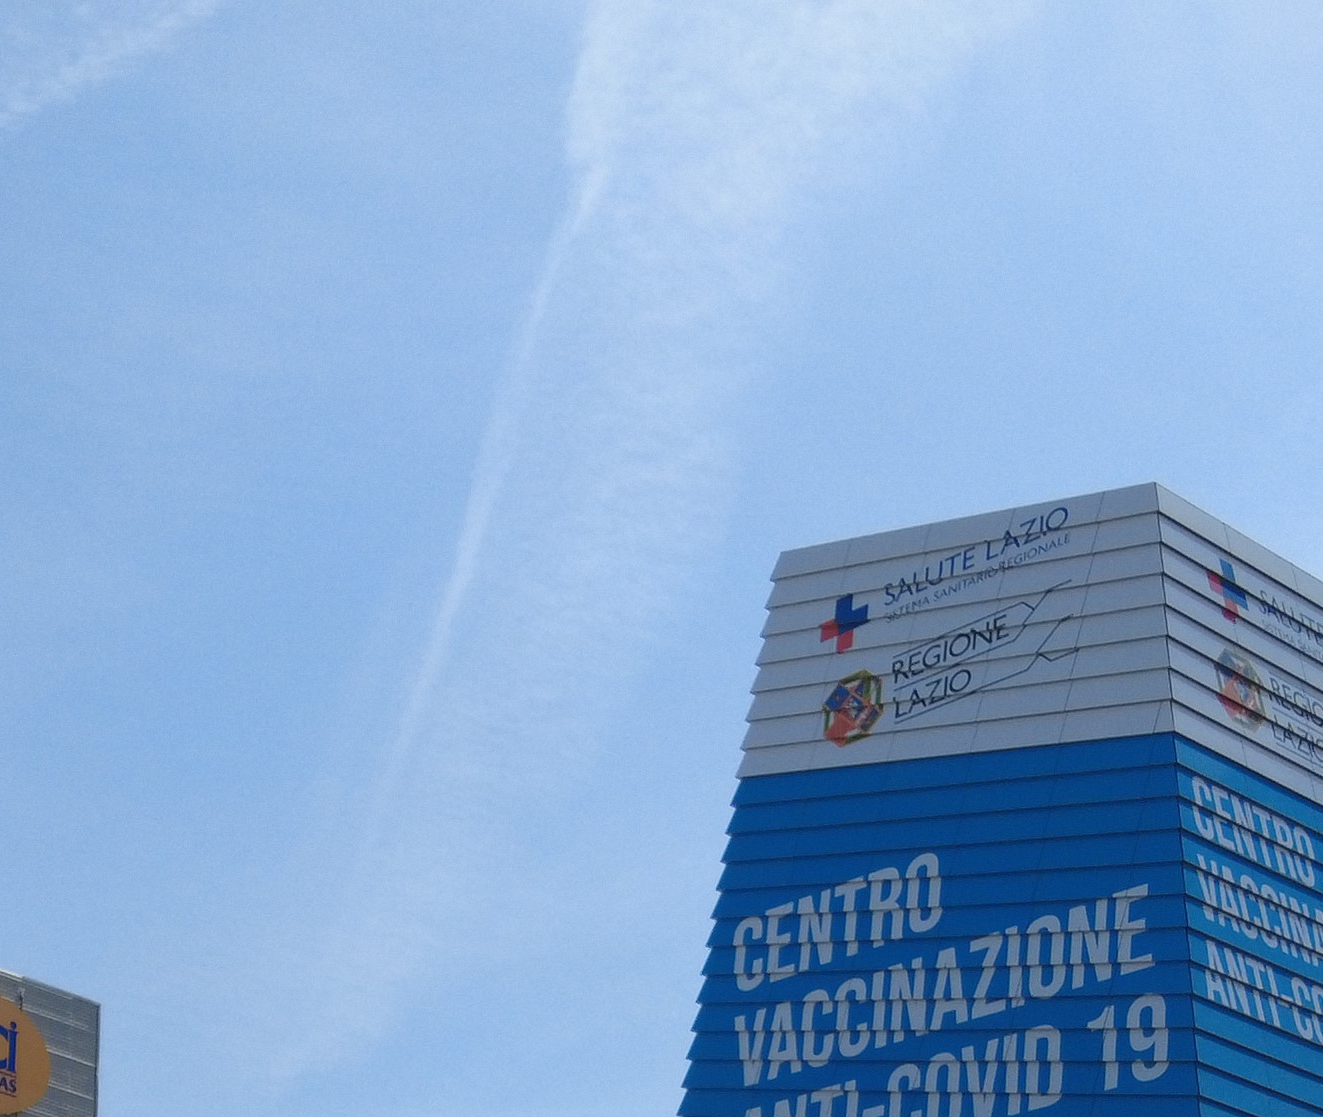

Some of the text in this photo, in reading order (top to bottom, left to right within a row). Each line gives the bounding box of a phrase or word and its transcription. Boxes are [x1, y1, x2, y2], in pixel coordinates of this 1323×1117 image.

[883, 533, 1070, 623] SISTEMA SANITARIO REGIONALE
[884, 507, 1068, 606] SALUTE LAZIO
[892, 615, 1009, 684] REGIONE
[893, 669, 971, 719] LAZIO
[1192, 775, 1316, 888] CENTRO
[733, 852, 943, 992] CENTRO
[734, 883, 1155, 1087] VACCINAZIONE
[1087, 992, 1170, 1091] 19
